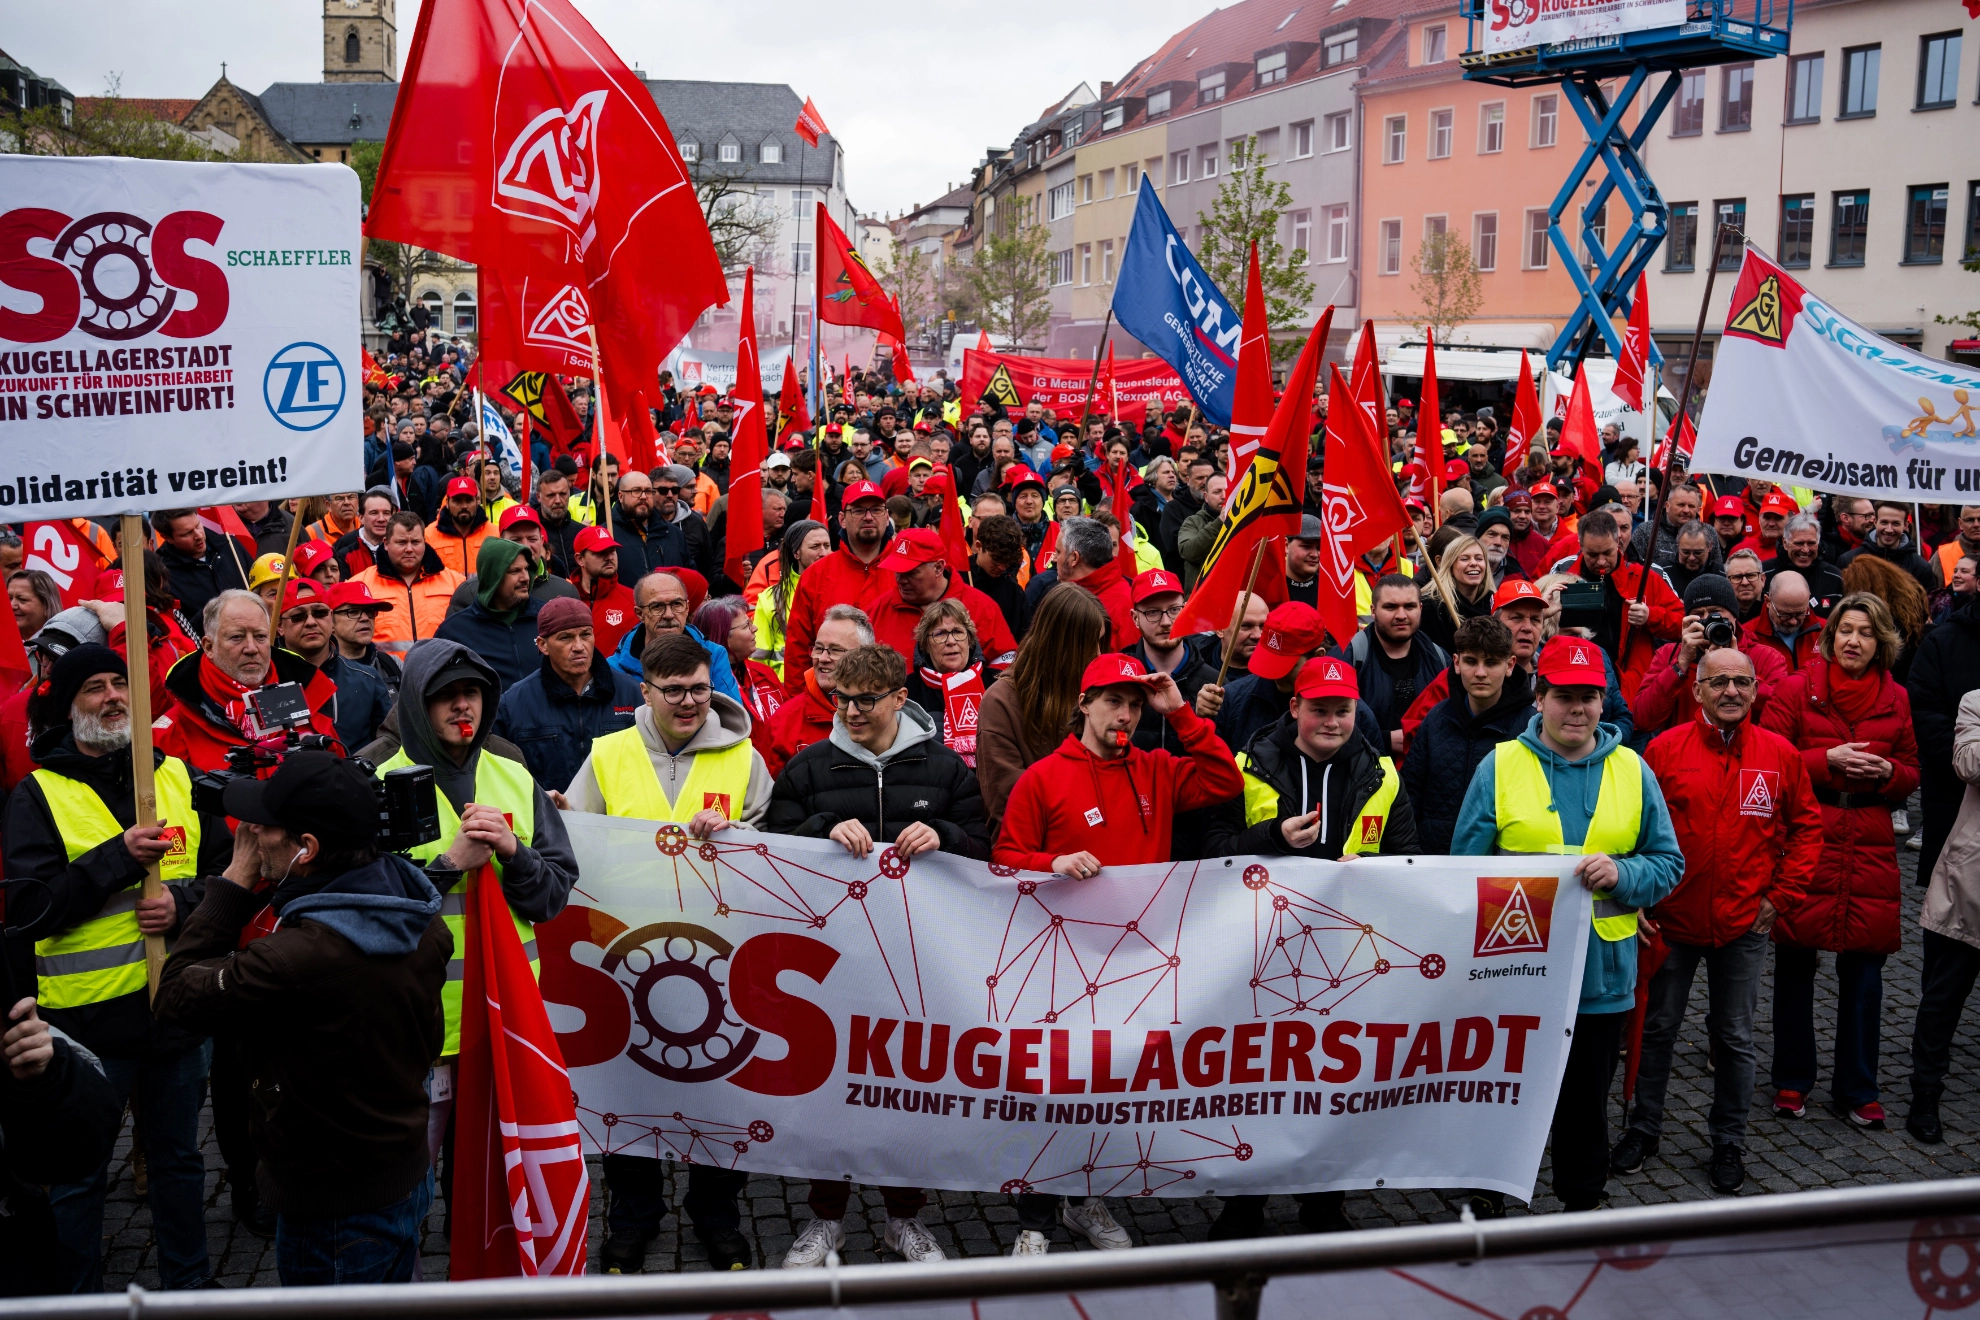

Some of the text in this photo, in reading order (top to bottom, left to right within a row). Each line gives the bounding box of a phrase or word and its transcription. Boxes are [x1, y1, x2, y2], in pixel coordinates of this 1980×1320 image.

[1541, 12, 1565, 21] ZUKUNFT
[1566, 9, 1576, 18] FÜR
[1577, 3, 1625, 16] INDUSTRIEARBEIT
[1556, 35, 1620, 53] SYSTEM LIFT
[227, 250, 352, 267] SCHAEFFLER
[0, 345, 232, 376] KUGELLAGERSTADT
[0, 369, 233, 393] ZUKUNFT FÜR INDUSTRIEARBEIT
[270, 360, 337, 414] ZF
[707, 374, 720, 382] bei
[723, 374, 735, 383] ZF
[1033, 377, 1047, 387] IG
[1050, 378, 1086, 389] Metall
[1185, 362, 1208, 405] METALL
[0, 385, 235, 422] IN SCHWEINFURT!
[1032, 392, 1052, 403] der
[1115, 391, 1160, 402] Rexroth
[1164, 390, 1183, 401] AG
[168, 456, 287, 492] vereint!
[1734, 437, 1898, 488] Gemeinsam
[1907, 458, 1946, 490] für
[1468, 963, 1547, 981] Schweinfurt
[534, 905, 842, 1097] SOS
[848, 1014, 1541, 1095] KUGELLAGERSTADT
[846, 1080, 1521, 1125] ZUKUNFT FÜR INDUSTRIEARBEIT IN SCHWEINFURT!
